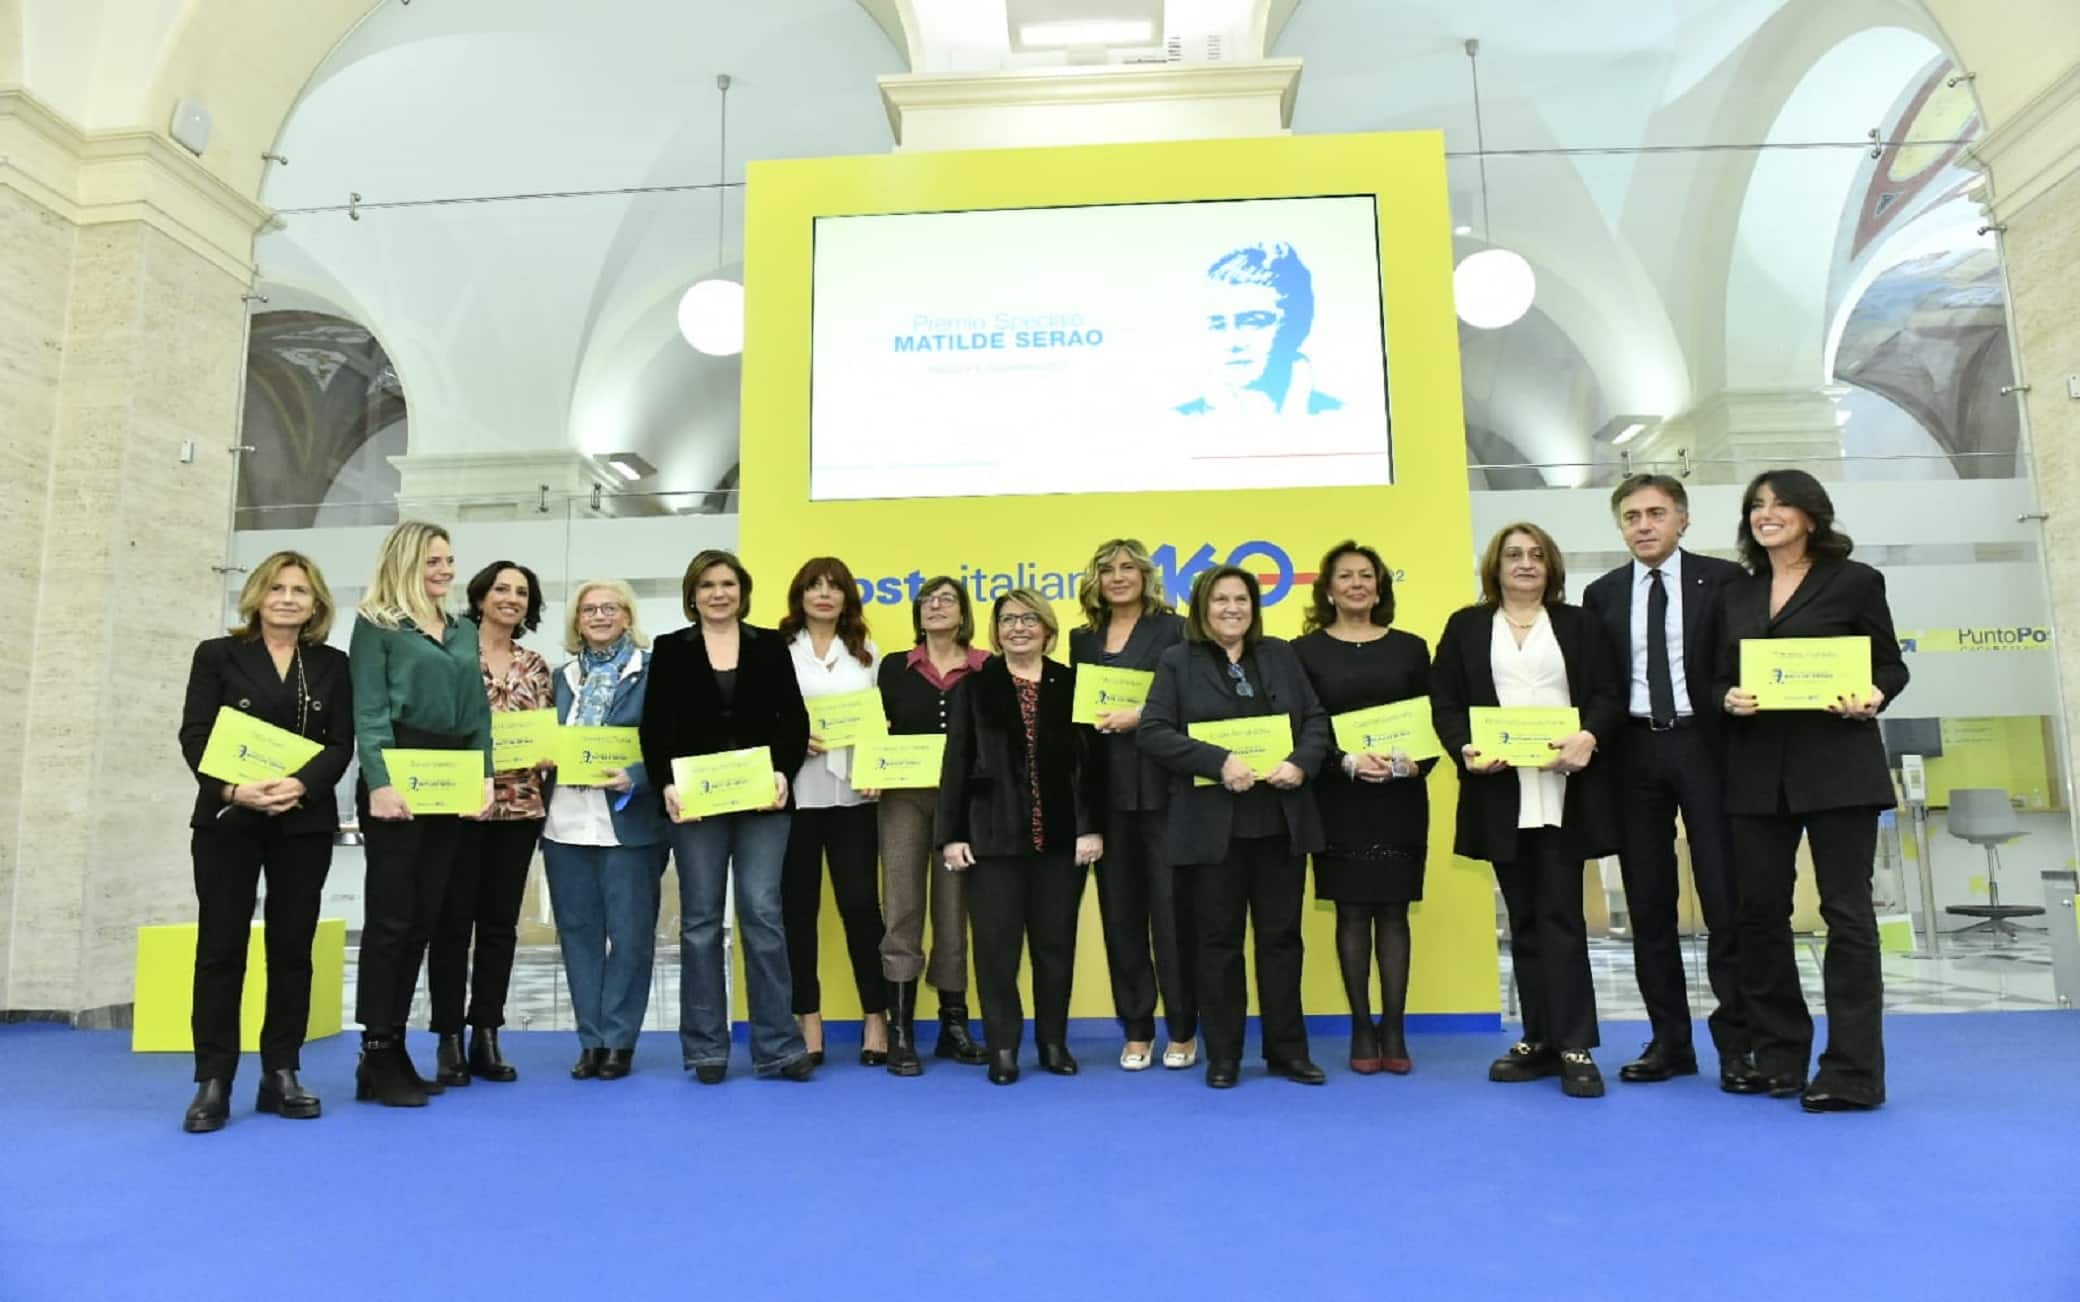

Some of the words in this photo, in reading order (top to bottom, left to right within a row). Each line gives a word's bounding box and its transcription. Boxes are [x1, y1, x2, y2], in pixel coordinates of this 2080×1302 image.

[912, 313, 986, 331] Premio
[894, 331, 1005, 352] MATILDE
[1015, 329, 1104, 348] SERAO
[853, 569, 926, 606] ost
[960, 562, 1088, 602] italian
[1958, 627, 2051, 645] PuntoPo
